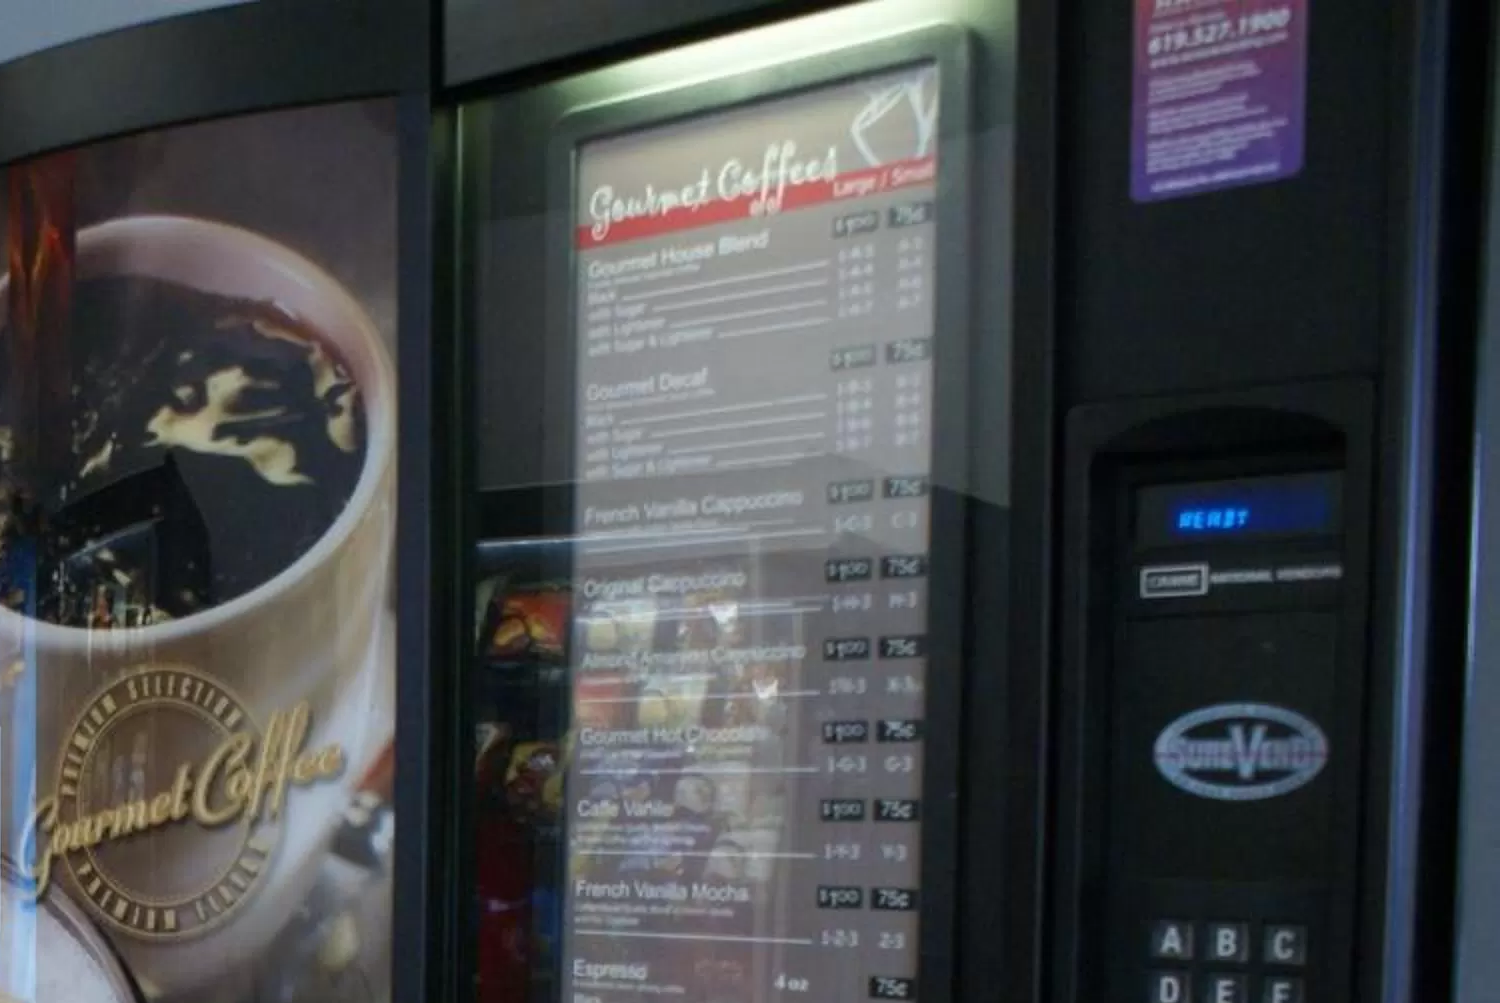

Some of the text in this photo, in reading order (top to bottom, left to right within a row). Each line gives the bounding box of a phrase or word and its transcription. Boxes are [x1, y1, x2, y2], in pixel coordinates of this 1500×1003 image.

[589, 168, 710, 241] Gourmet
[190, 700, 343, 828] Coffee
[575, 880, 630, 899] French
[691, 884, 751, 904] Mocha
[1161, 927, 1294, 960] A B C
[572, 958, 648, 982] Espresso
[1160, 976, 1179, 1003] D
